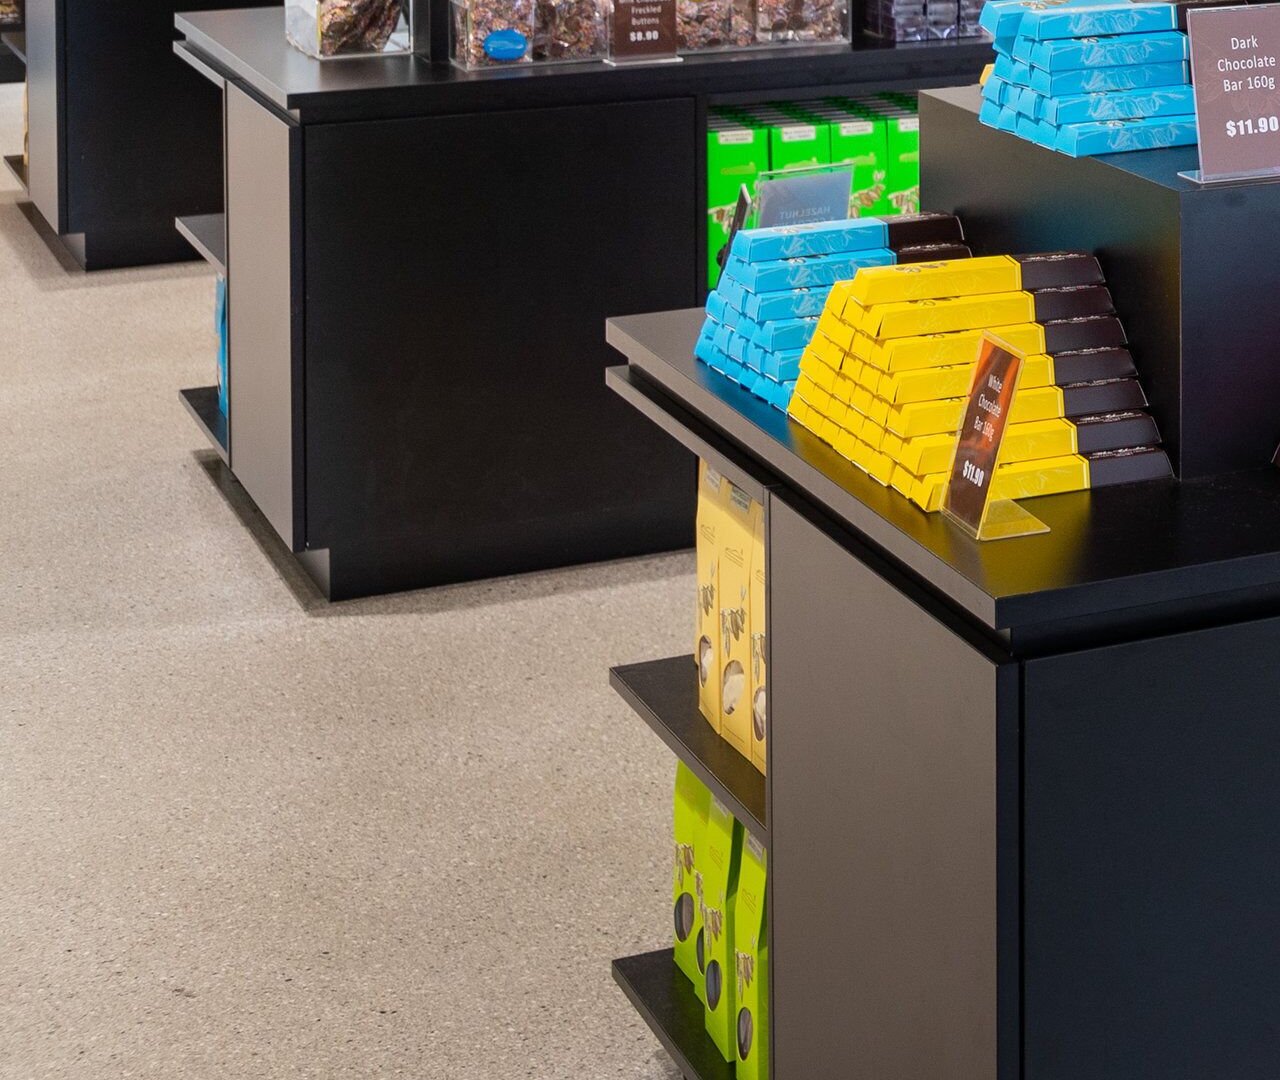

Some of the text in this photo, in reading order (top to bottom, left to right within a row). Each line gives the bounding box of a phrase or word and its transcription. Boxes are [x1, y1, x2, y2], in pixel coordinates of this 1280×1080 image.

[631, 5, 662, 14] Freckled
[631, 17, 660, 26] Buttons
[1231, 35, 1258, 50] Dark
[1217, 55, 1276, 72] Chocolate
[1223, 75, 1275, 92] Bar 160g
[1226, 116, 1279, 137] $11.90
[987, 374, 1003, 394] White
[978, 393, 1002, 418] Chocolate
[973, 416, 995, 442] Bar 160g
[963, 460, 985, 488] $11.90
